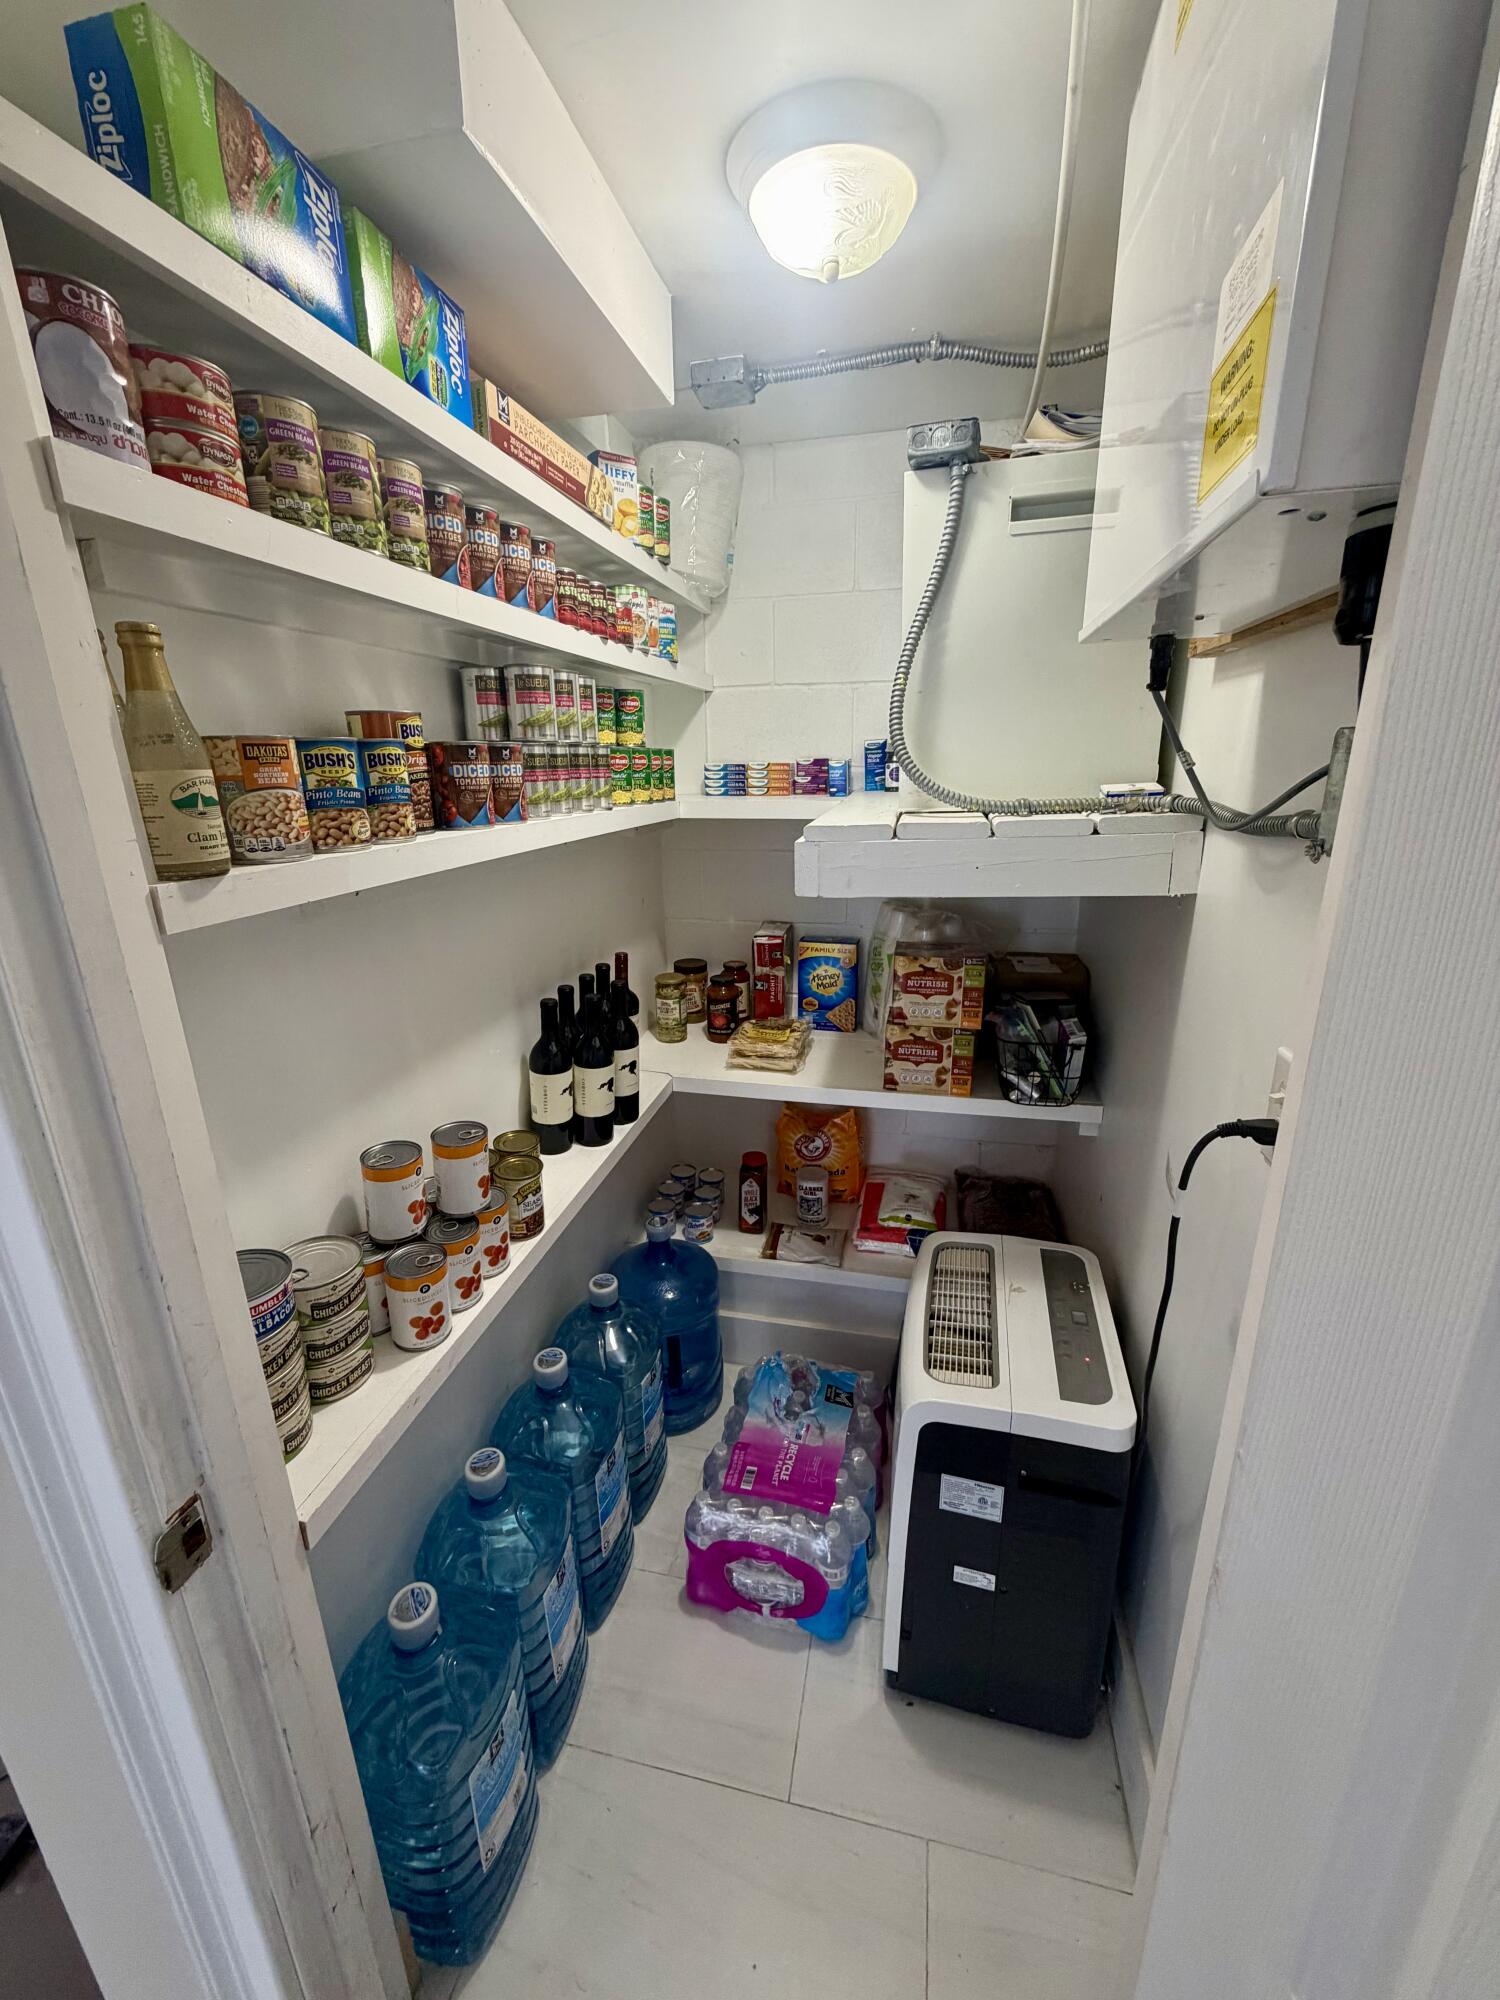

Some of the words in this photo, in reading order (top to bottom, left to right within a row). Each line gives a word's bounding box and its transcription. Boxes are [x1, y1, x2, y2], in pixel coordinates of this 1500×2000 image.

[88, 69, 125, 172] Ziploc
[303, 168, 337, 270] Ziplo
[442, 301, 464, 396] Ziploc
[186, 403, 216, 421] Water
[85, 413, 105, 427] 13.5
[269, 428, 294, 439] GREEN
[514, 421, 561, 464] PARCHMENT
[327, 459, 349, 469] GREEN
[350, 462, 369, 474] BEANS
[182, 472, 214, 487] Water
[427, 512, 462, 534] ICED
[427, 529, 462, 543] OMATOES
[467, 544, 499, 556] OMATOES
[303, 752, 355, 771] BUSH'S
[453, 764, 490, 778] DICED
[178, 779, 197, 794] BAR
[455, 778, 490, 787] TOMATOES
[305, 788, 333, 800] Pinto
[335, 788, 361, 799] Beans
[367, 786, 393, 797] Pinto
[187, 831, 218, 844] Clam
[811, 972, 841, 982] Honey
[816, 979, 838, 990] Maid
[907, 980, 949, 988] NUTRISH
[898, 1048, 938, 1057] NUTRISH
[250, 1291, 284, 1317] UMBLE
[312, 1297, 349, 1319] CHICKEN
[308, 1340, 346, 1360] CHICKEN
[347, 1319, 369, 1343] BREAST
[311, 1378, 347, 1398] CHICKEN
[348, 1357, 372, 1382] BREAST
[780, 1442, 799, 1481] RECYCLE
